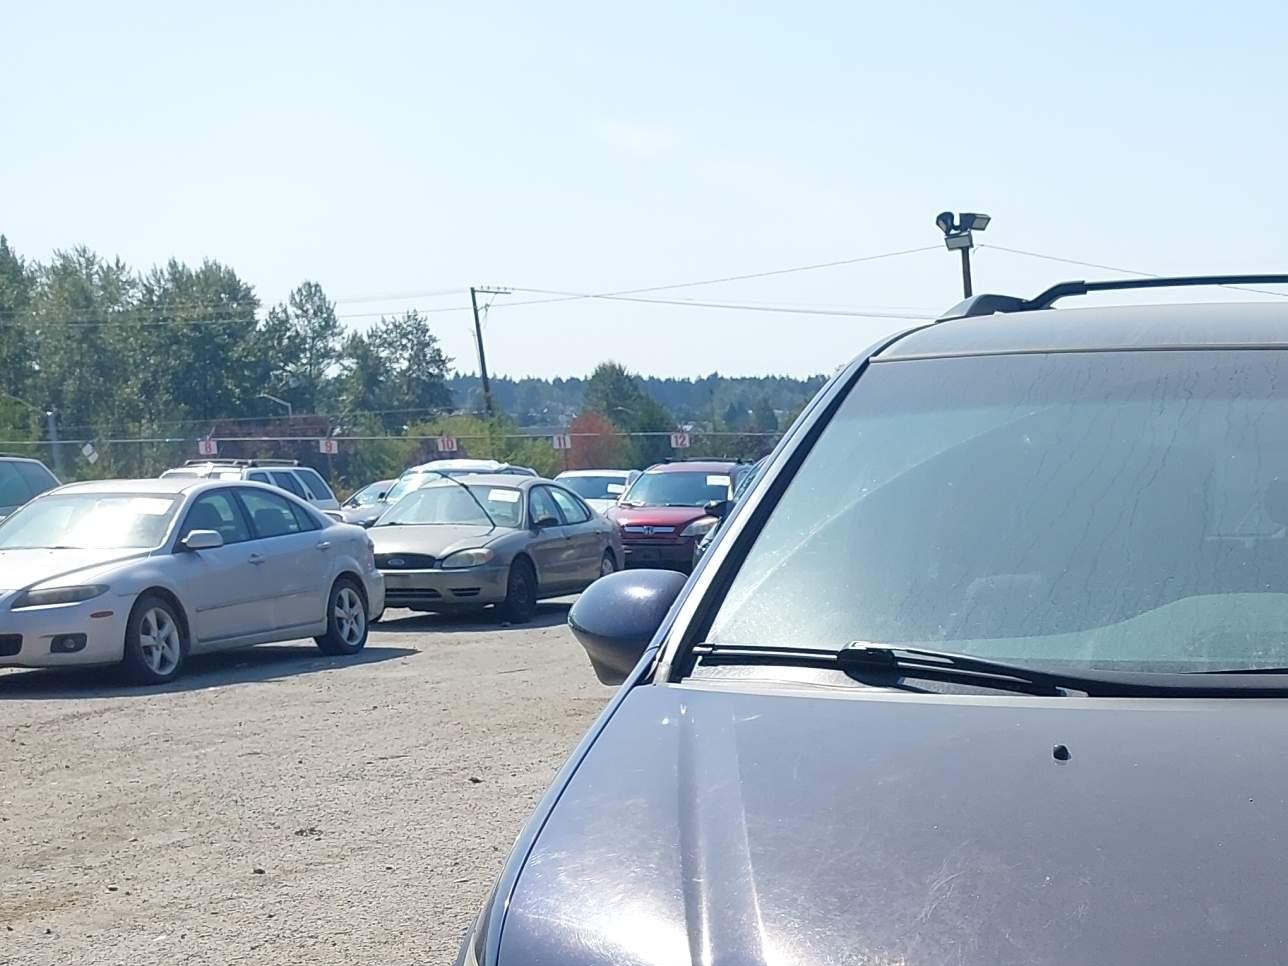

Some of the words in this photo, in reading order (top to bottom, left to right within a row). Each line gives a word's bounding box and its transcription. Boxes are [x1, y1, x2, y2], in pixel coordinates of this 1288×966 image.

[440, 438, 455, 450] 10
[556, 436, 567, 448] 11
[673, 435, 688, 447] 12
